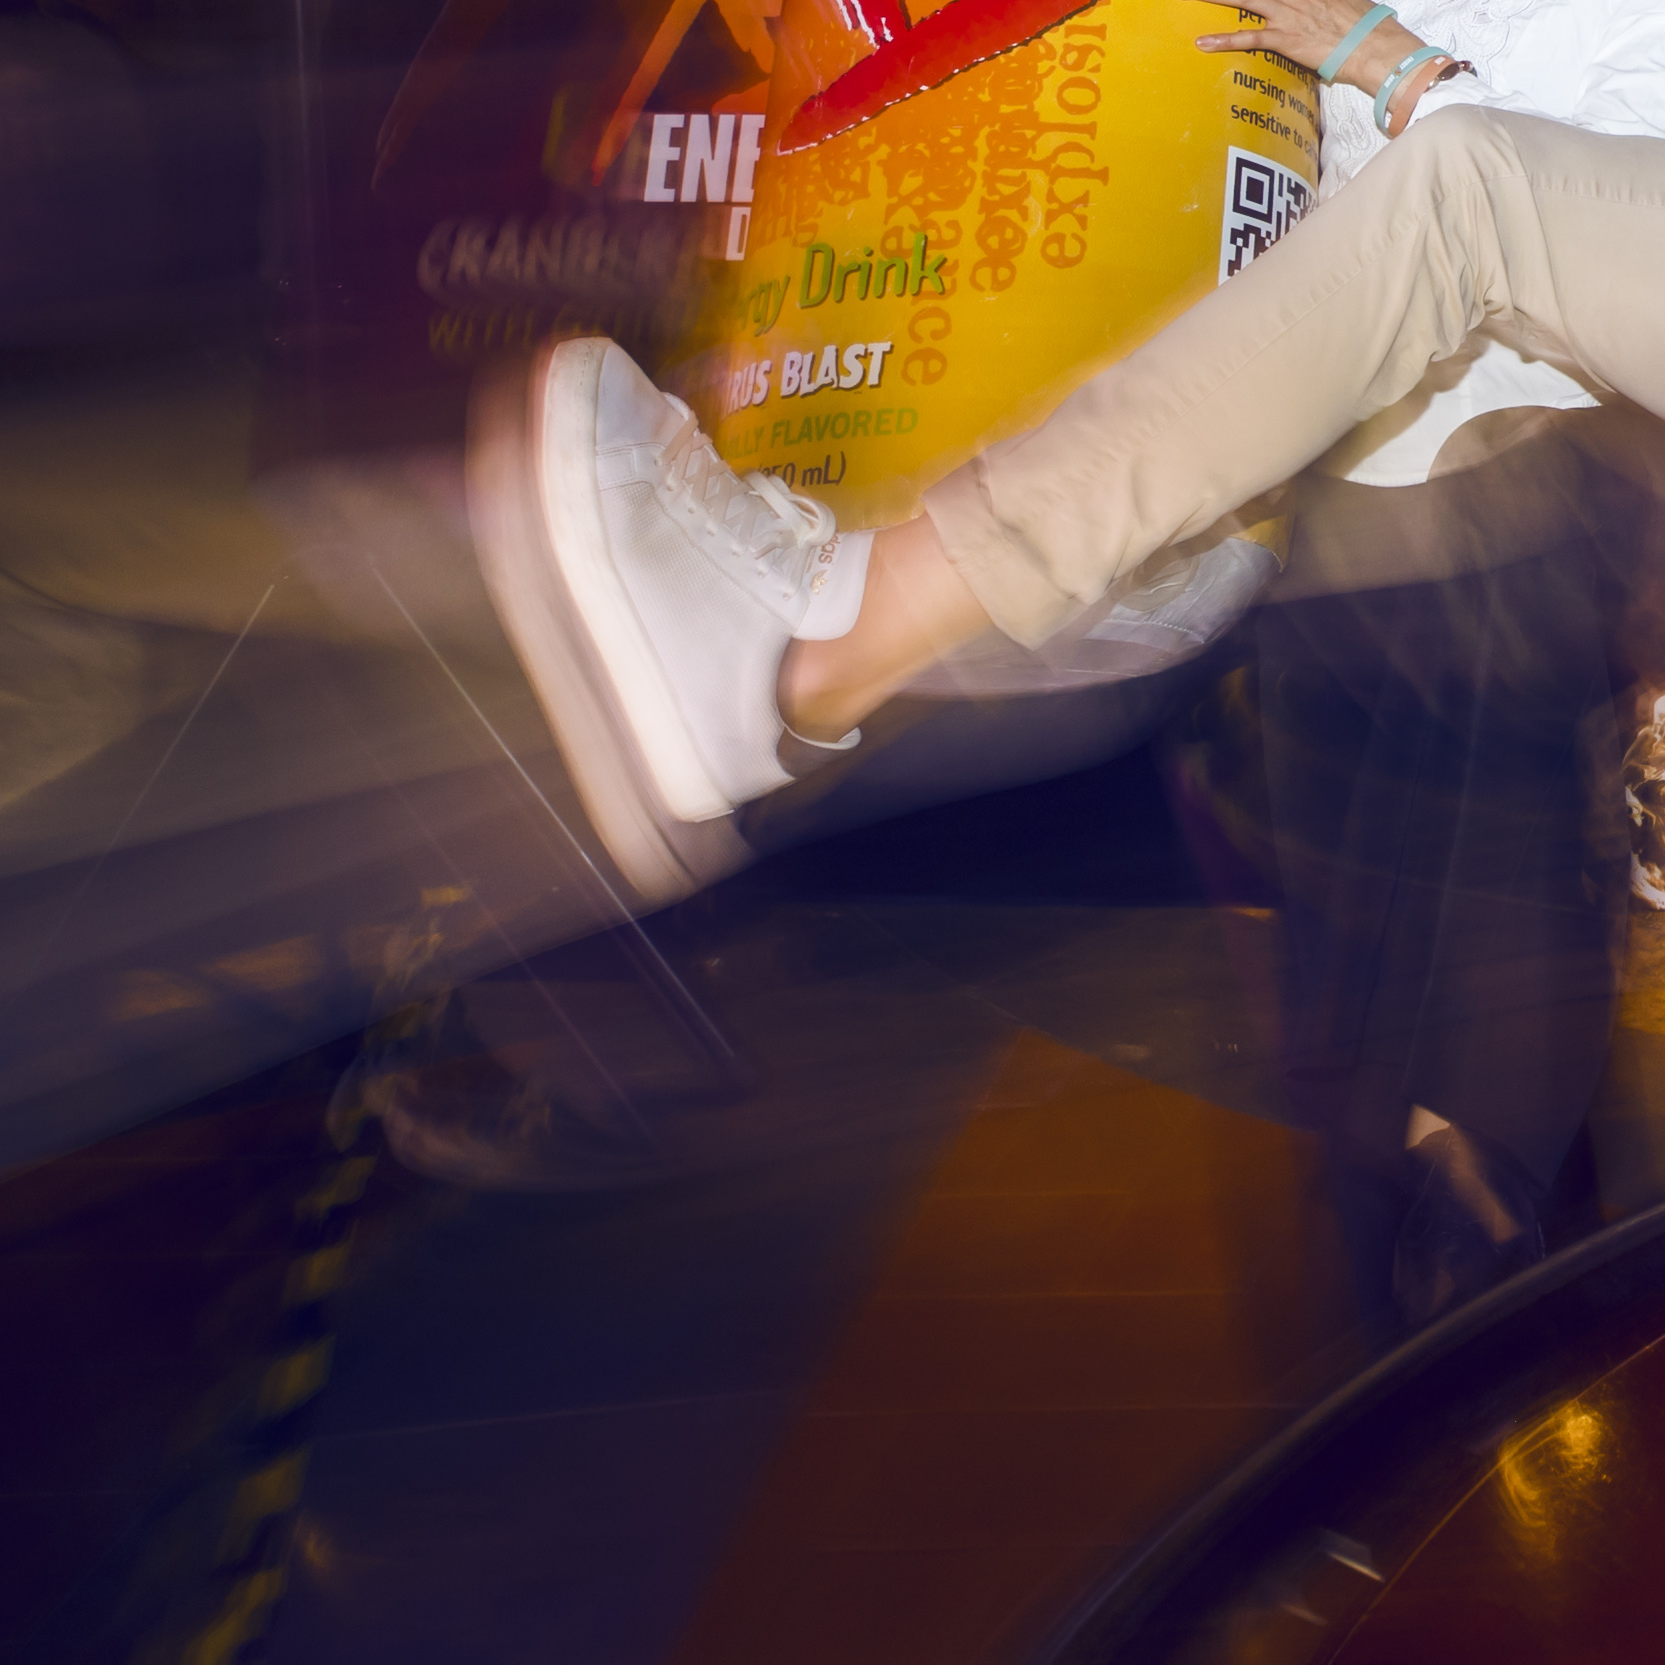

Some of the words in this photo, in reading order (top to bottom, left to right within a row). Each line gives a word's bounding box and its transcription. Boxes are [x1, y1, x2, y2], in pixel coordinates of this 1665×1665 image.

[1233, 69, 1286, 108] nursing
[1231, 104, 1291, 141] sensitive
[799, 232, 948, 310] Drink
[780, 341, 893, 398] BLAST
[771, 408, 919, 449] FLAVORED
[801, 451, 847, 487] mL)
